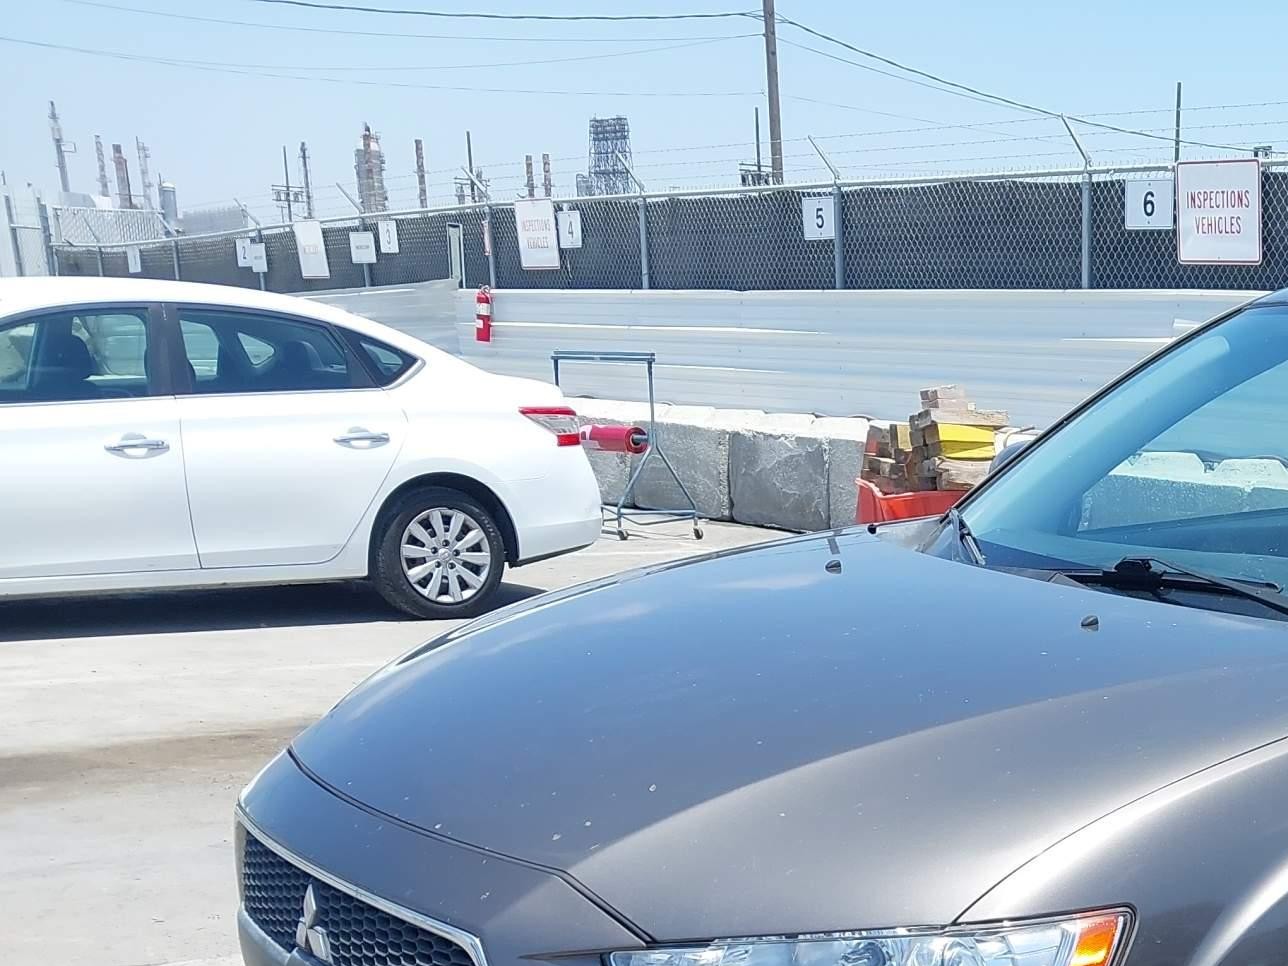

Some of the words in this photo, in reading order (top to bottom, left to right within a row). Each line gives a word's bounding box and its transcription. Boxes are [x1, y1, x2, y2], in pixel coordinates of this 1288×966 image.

[1143, 190, 1156, 217] 6
[1186, 190, 1251, 209] INSPECTIONS
[816, 207, 825, 229] 5
[1195, 215, 1243, 235] VEHICLES
[567, 220, 574, 239] 4
